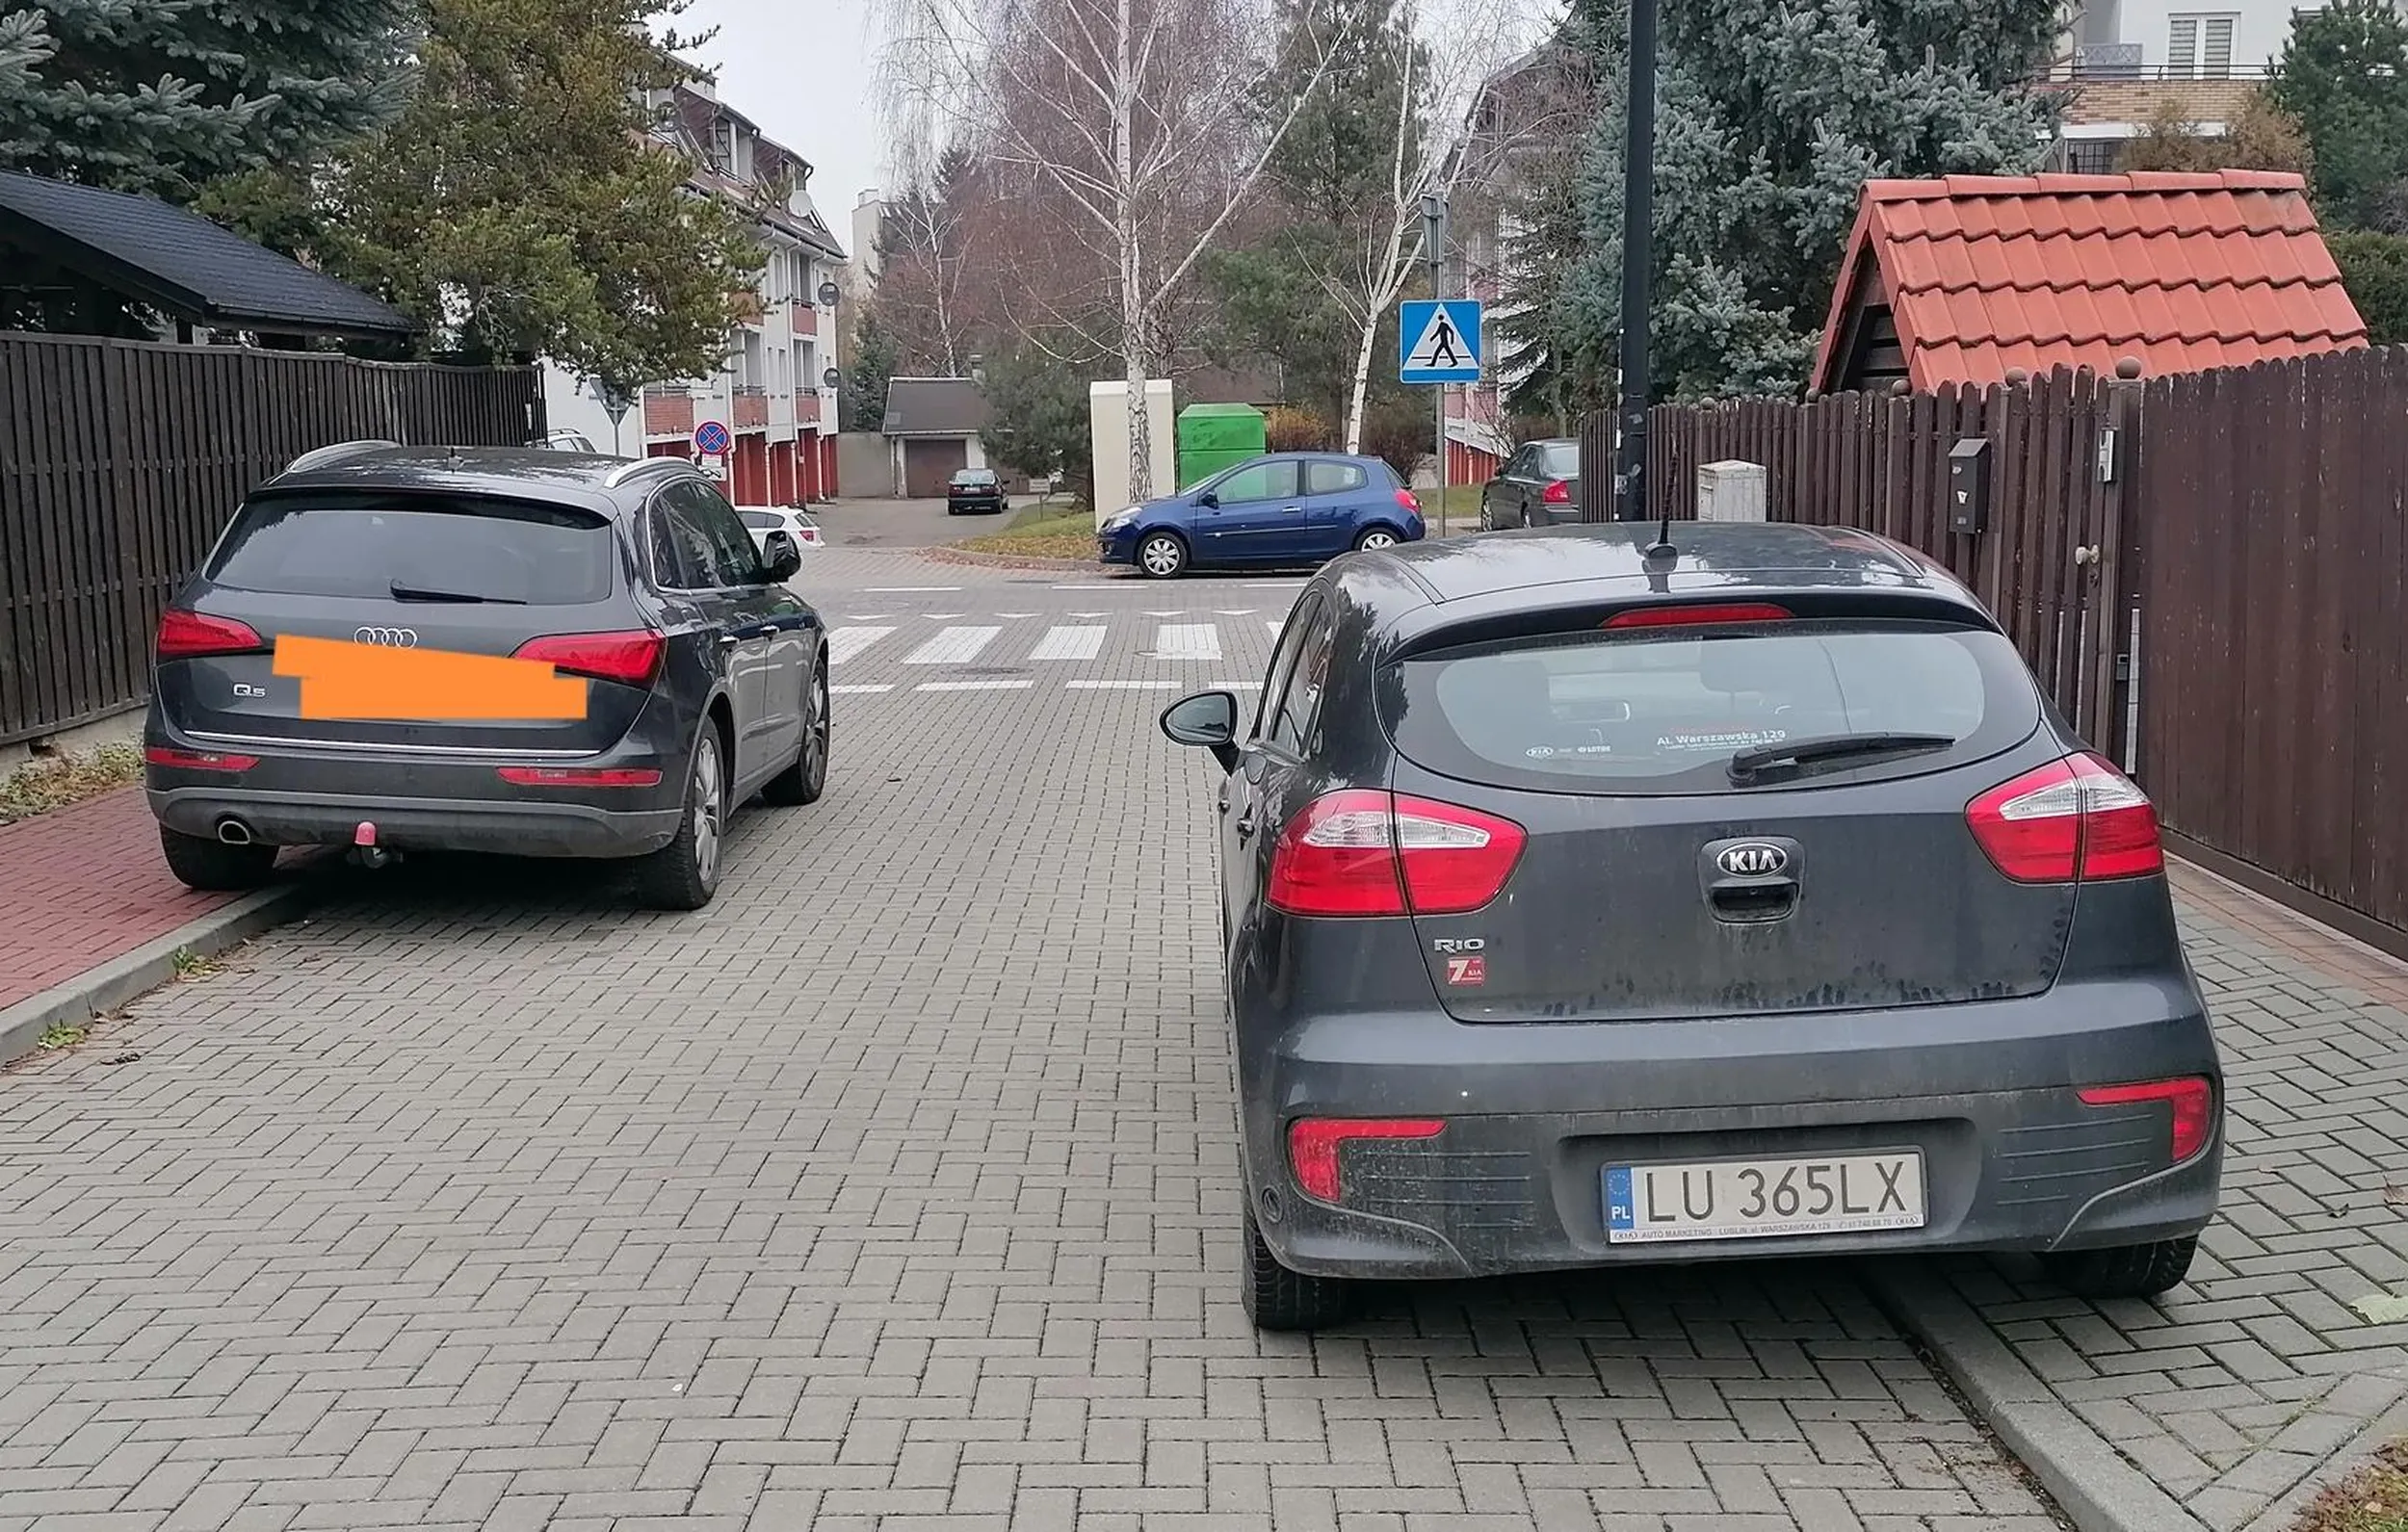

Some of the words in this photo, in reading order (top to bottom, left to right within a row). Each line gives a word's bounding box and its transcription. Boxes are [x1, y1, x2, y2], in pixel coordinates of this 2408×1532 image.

[233, 684, 266, 698] Q5
[1763, 729, 1786, 739] 129
[1728, 850, 1778, 871] KIA
[1434, 939, 1484, 953] RIO
[1449, 959, 1470, 982] 7
[1645, 1170, 1714, 1223] LU
[1737, 1161, 1907, 1218] 365LX
[1611, 1206, 1631, 1220] PL
